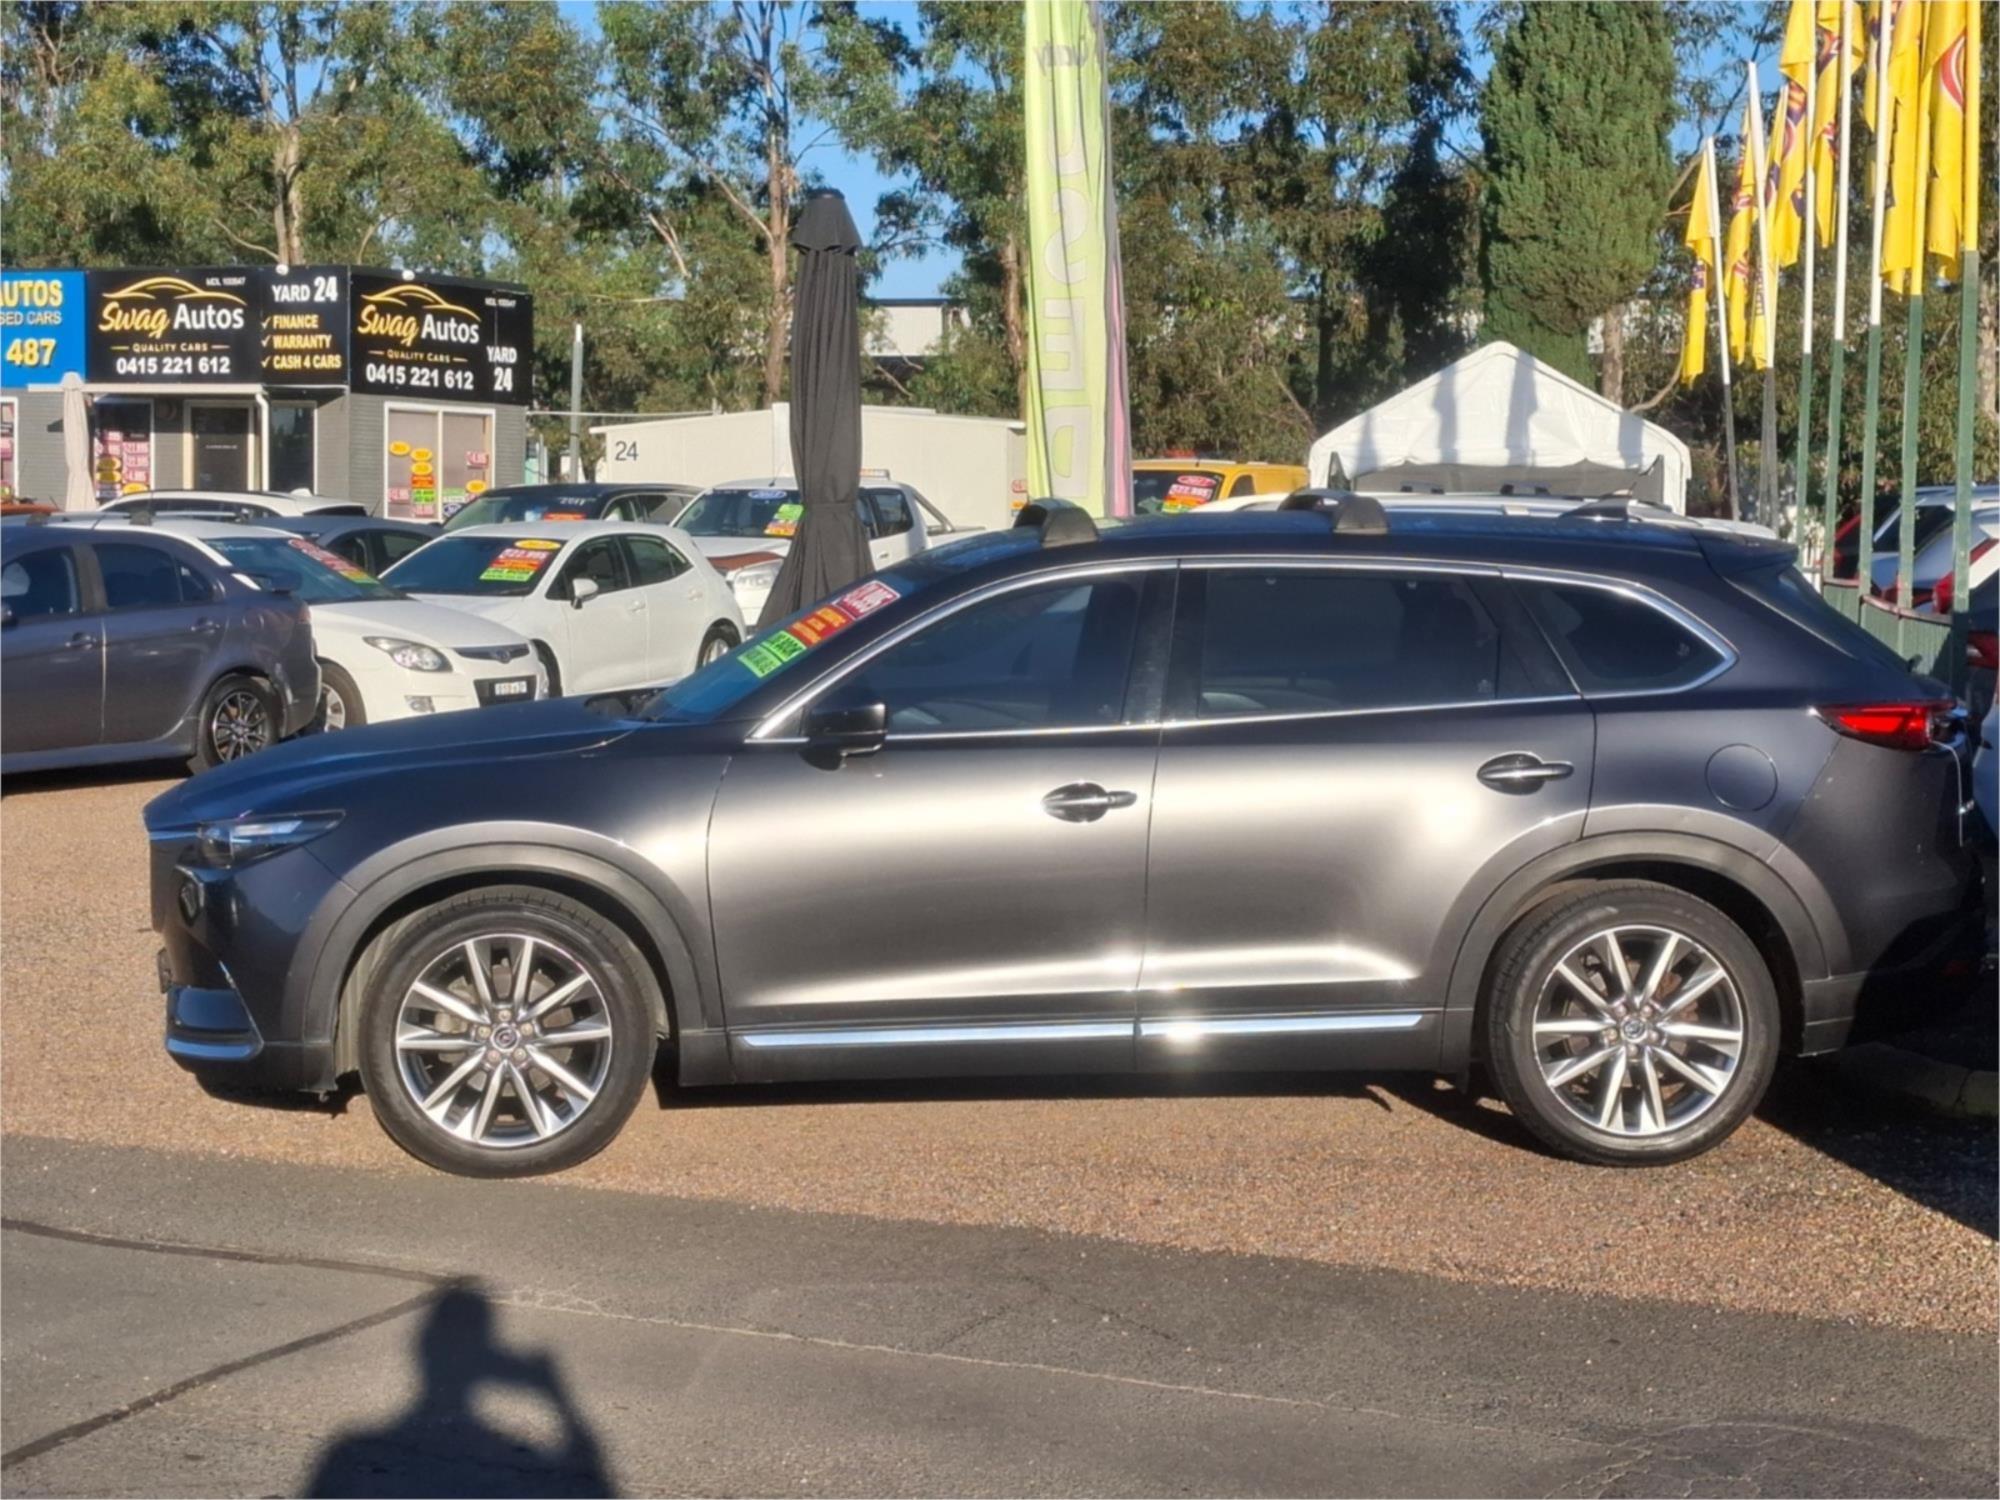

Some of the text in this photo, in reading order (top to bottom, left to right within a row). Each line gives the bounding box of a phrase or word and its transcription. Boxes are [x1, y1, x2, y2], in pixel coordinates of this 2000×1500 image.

[272, 276, 338, 302] YARD 24
[27, 311, 62, 325] CARS
[99, 301, 244, 339] Swag Autos
[273, 314, 319, 329] FINANCE
[357, 304, 479, 346] Swag Autos
[132, 342, 208, 353] QUALITY CARS
[273, 335, 332, 349] WARRANTY
[6, 338, 57, 366] 487
[386, 349, 450, 363] QUALITY CARS
[486, 345, 518, 363] YARD
[116, 356, 231, 375] 0415 221 612
[273, 355, 342, 369] CASH 4 CARS
[366, 363, 474, 390] 0415 221 612
[494, 367, 513, 391] 24
[615, 440, 639, 461] 24
